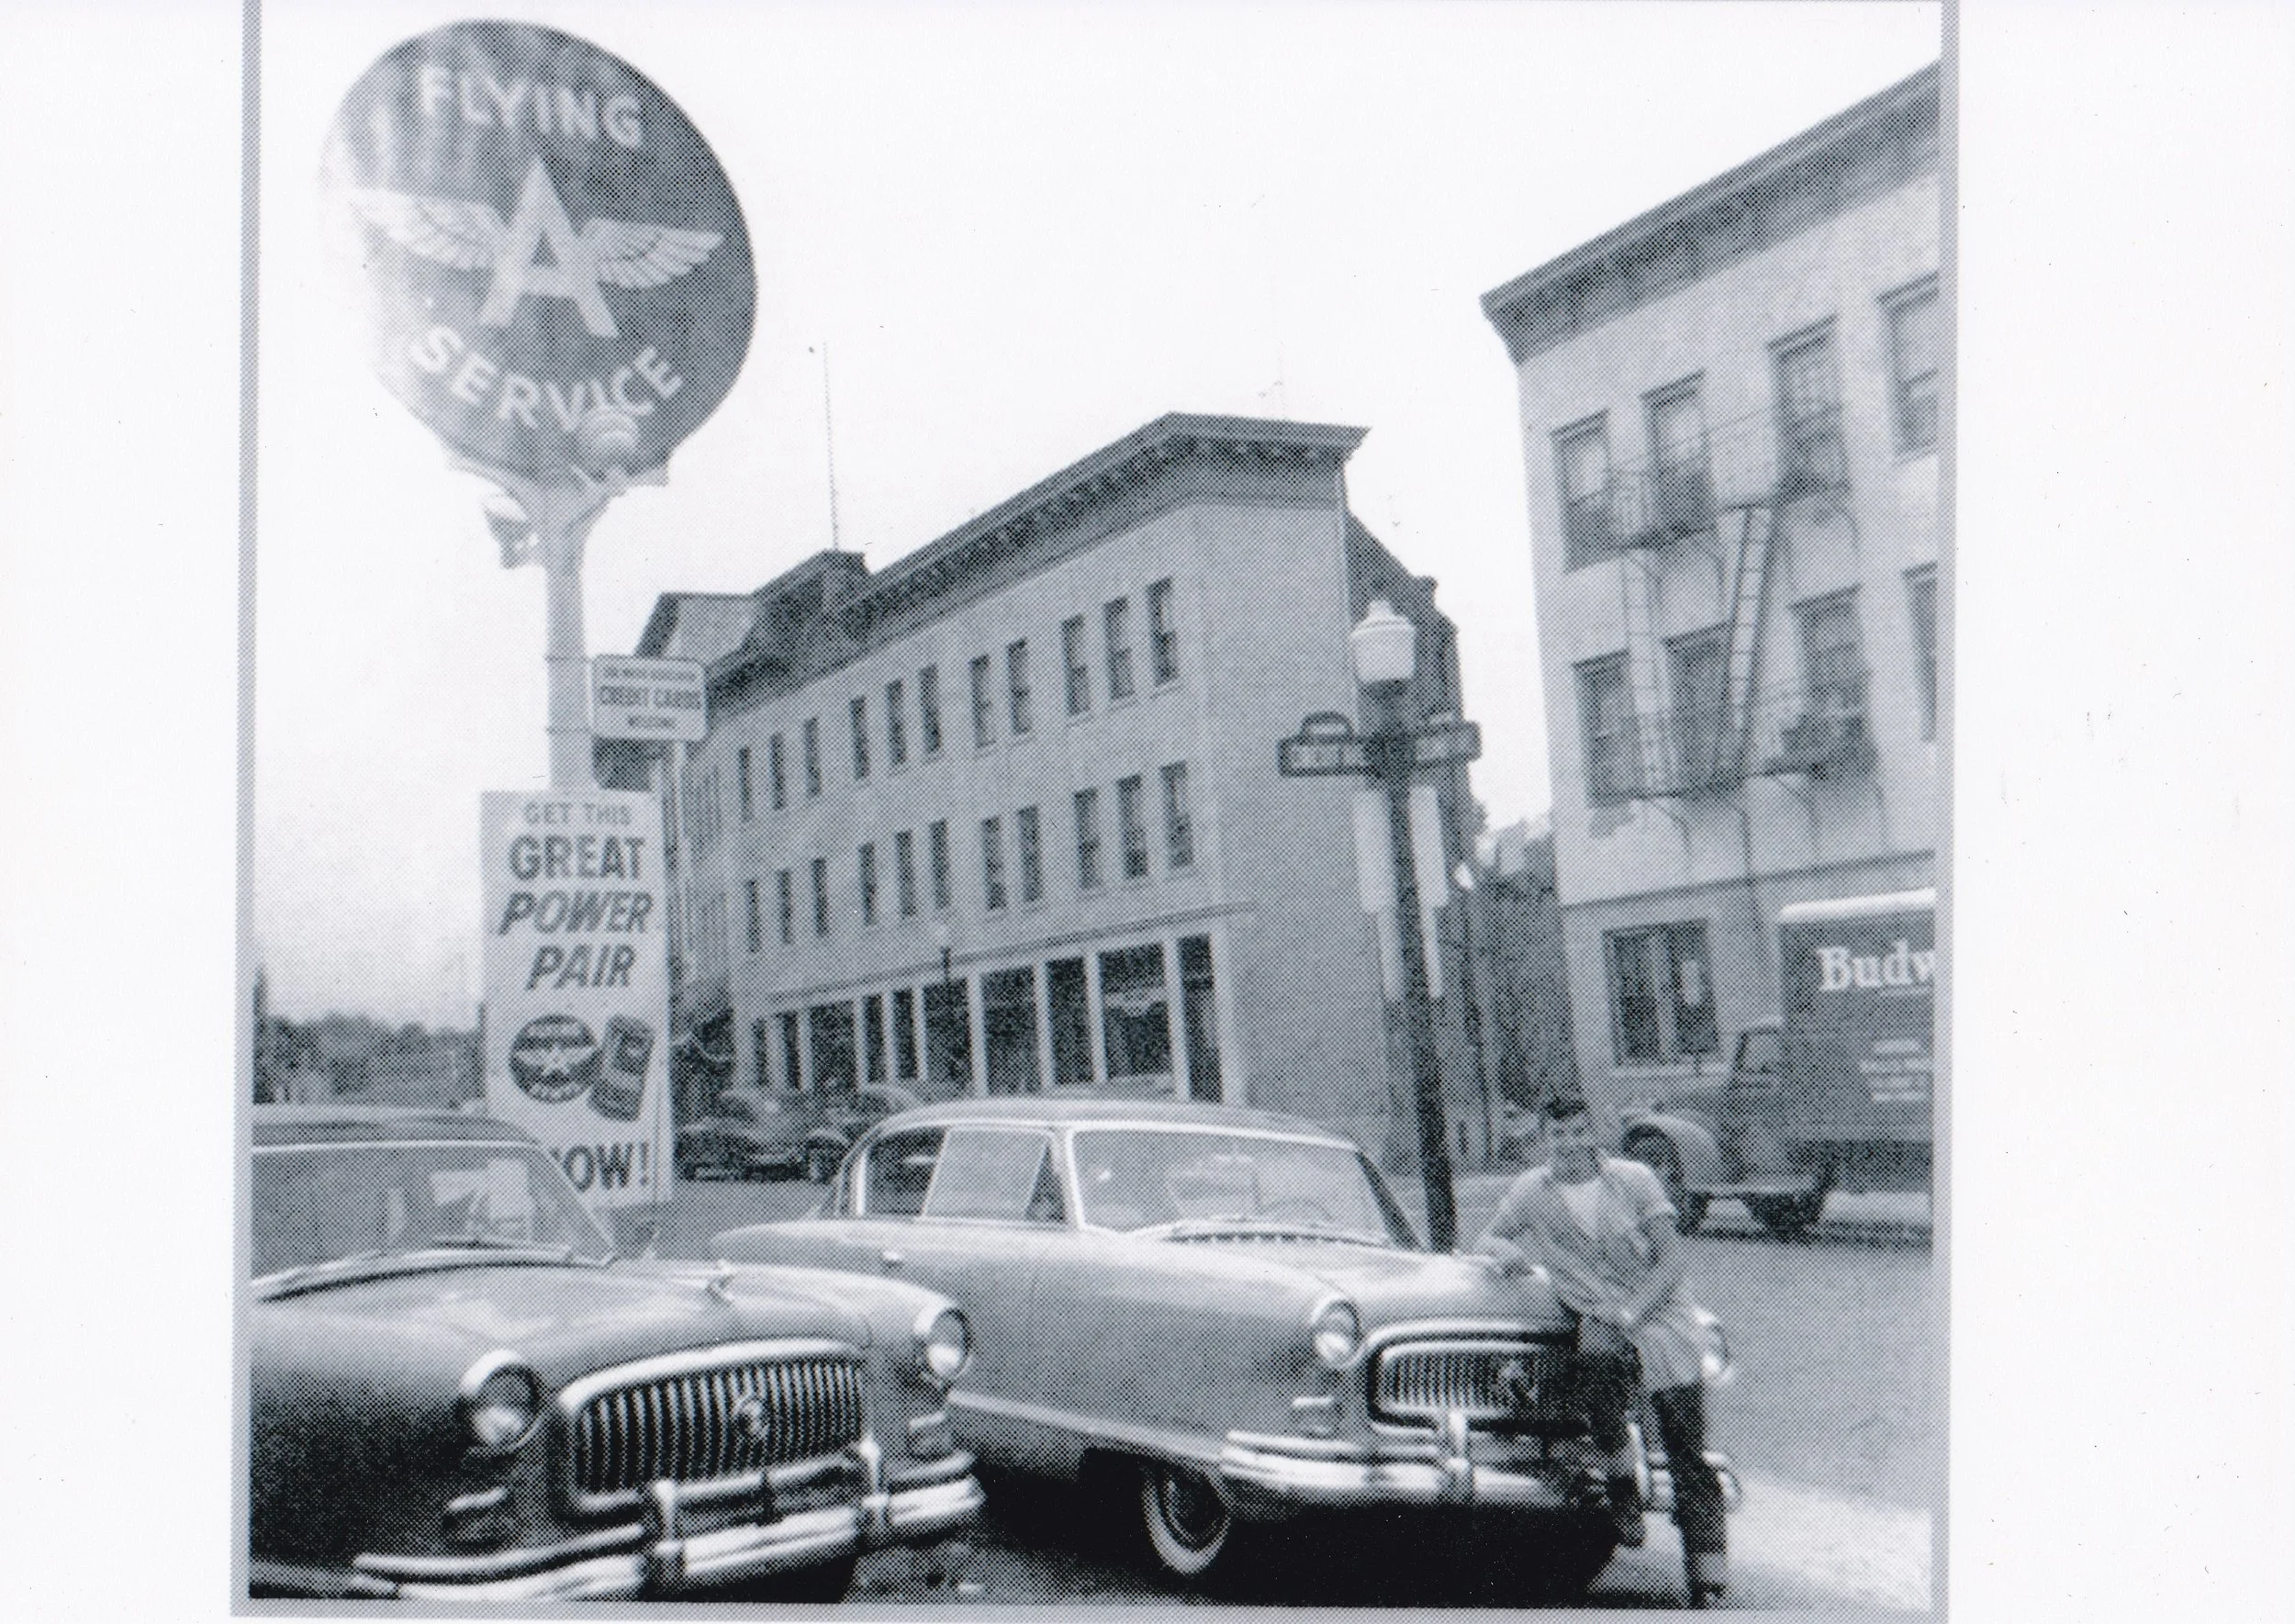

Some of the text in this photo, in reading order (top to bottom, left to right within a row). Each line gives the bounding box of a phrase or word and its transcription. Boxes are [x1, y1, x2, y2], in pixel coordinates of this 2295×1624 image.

[417, 62, 644, 150] FLYING
[478, 151, 621, 338] A
[409, 324, 684, 434] SERVICE
[599, 685, 649, 707] CREDIT
[523, 801, 632, 826] GET THIS
[509, 834, 645, 881] GREAT
[498, 890, 655, 935] POWER
[525, 944, 637, 991] PAIR
[551, 1142, 649, 1193] OW!
